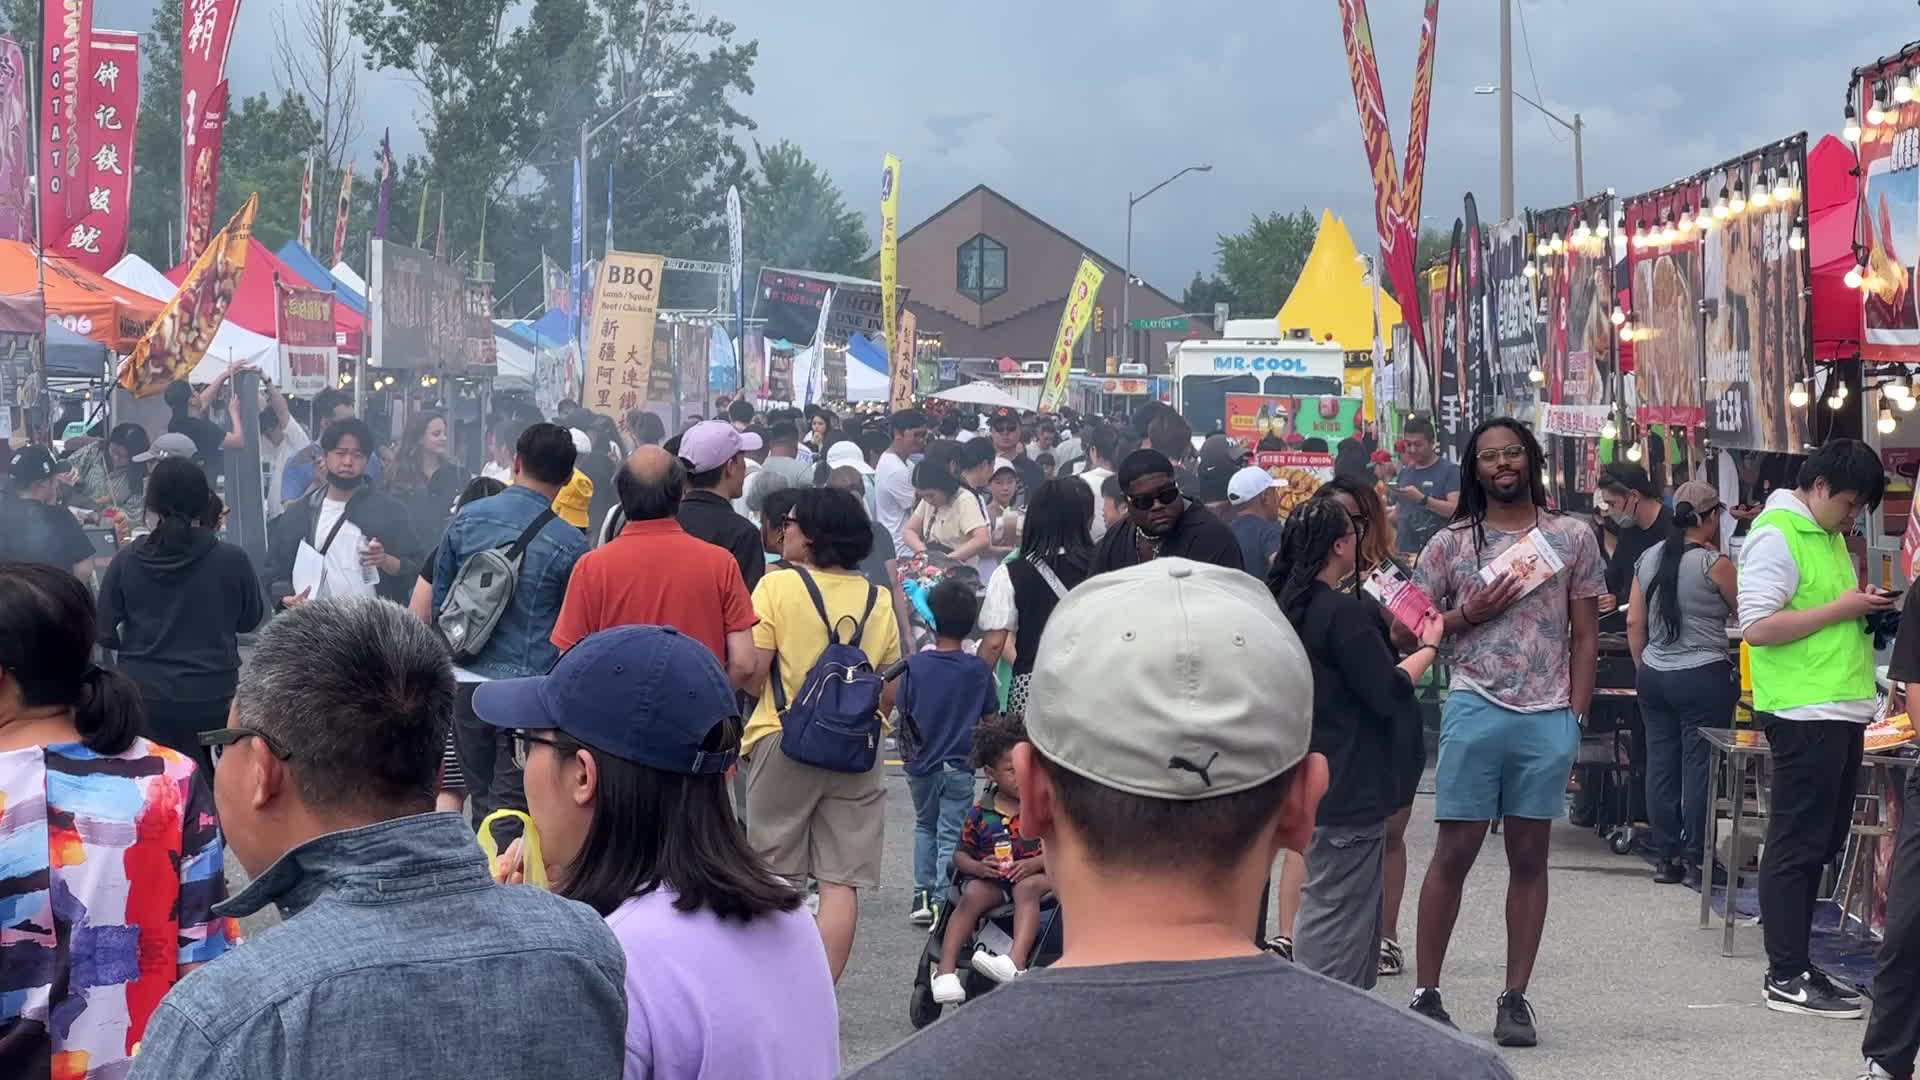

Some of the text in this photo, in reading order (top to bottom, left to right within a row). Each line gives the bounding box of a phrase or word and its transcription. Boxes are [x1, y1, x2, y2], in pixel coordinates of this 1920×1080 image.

[51, 46, 61, 194] POTATO
[607, 265, 653, 291] BBQ
[623, 304, 653, 314] Chicken
[1140, 319, 1172, 329] CLAYTON
[595, 318, 619, 408] 新疆阿里
[1251, 356, 1307, 373] COOL
